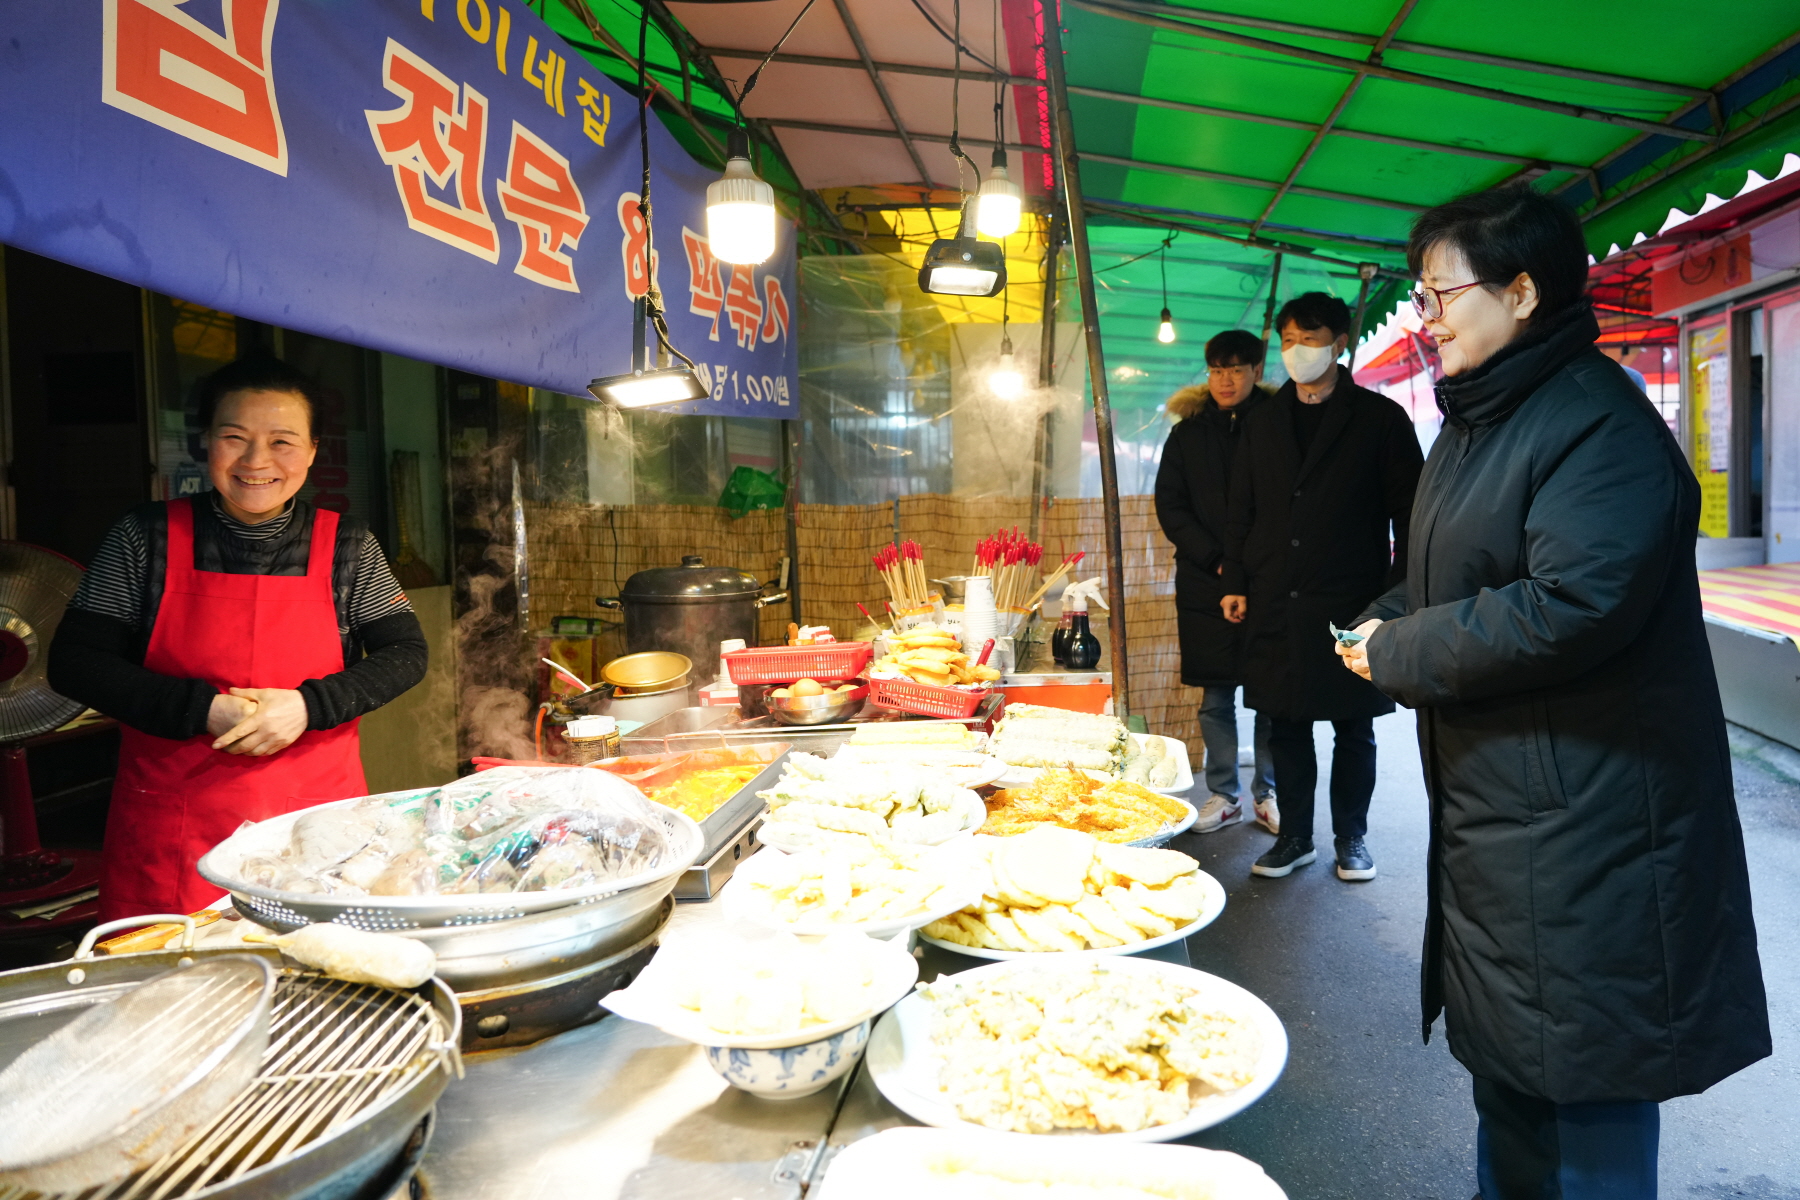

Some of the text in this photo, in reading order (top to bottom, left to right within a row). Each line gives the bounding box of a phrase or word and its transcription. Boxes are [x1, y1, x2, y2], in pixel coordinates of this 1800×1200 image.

[420, 0, 611, 148] 이네집
[364, 36, 591, 294] 전문
[179, 476, 202, 495] ADT
